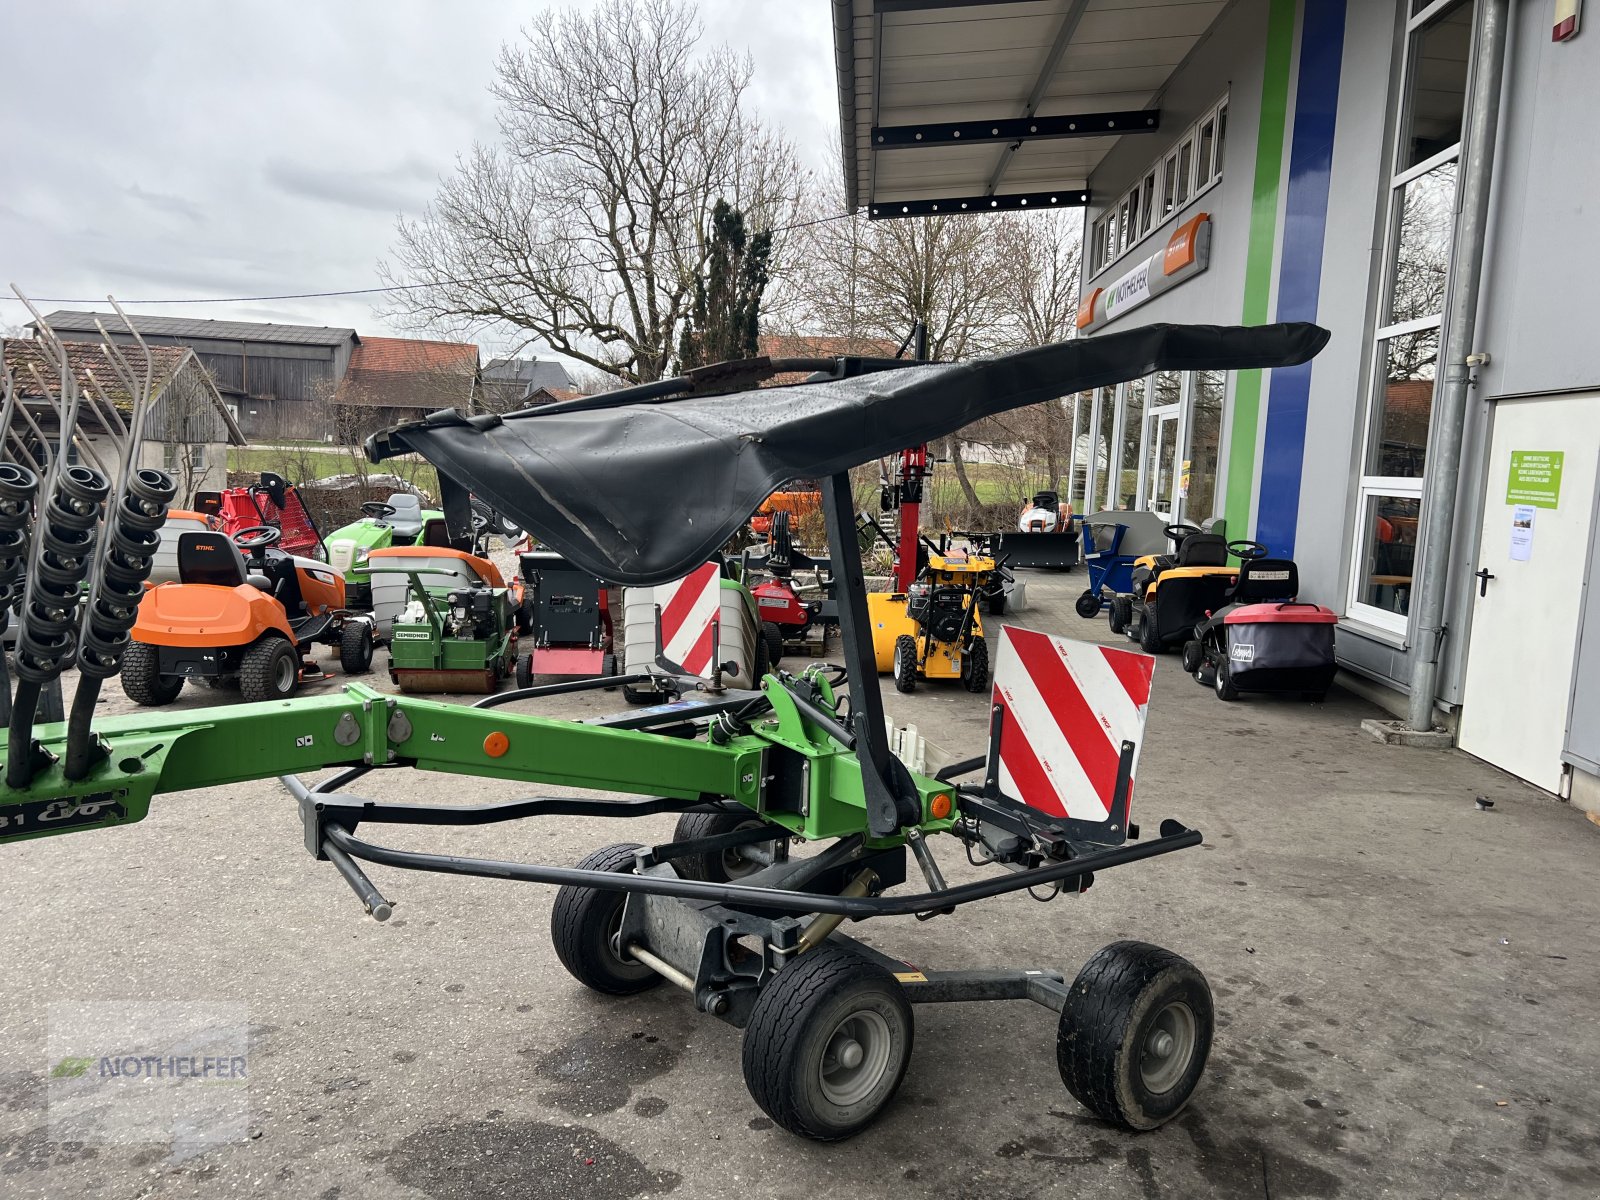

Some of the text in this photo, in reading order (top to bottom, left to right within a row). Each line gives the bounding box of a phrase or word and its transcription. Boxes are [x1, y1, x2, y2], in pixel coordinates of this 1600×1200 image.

[1115, 268, 1147, 304] NOTHELFER
[1100, 715, 1112, 729] WGF
[38, 801, 116, 822] Evo
